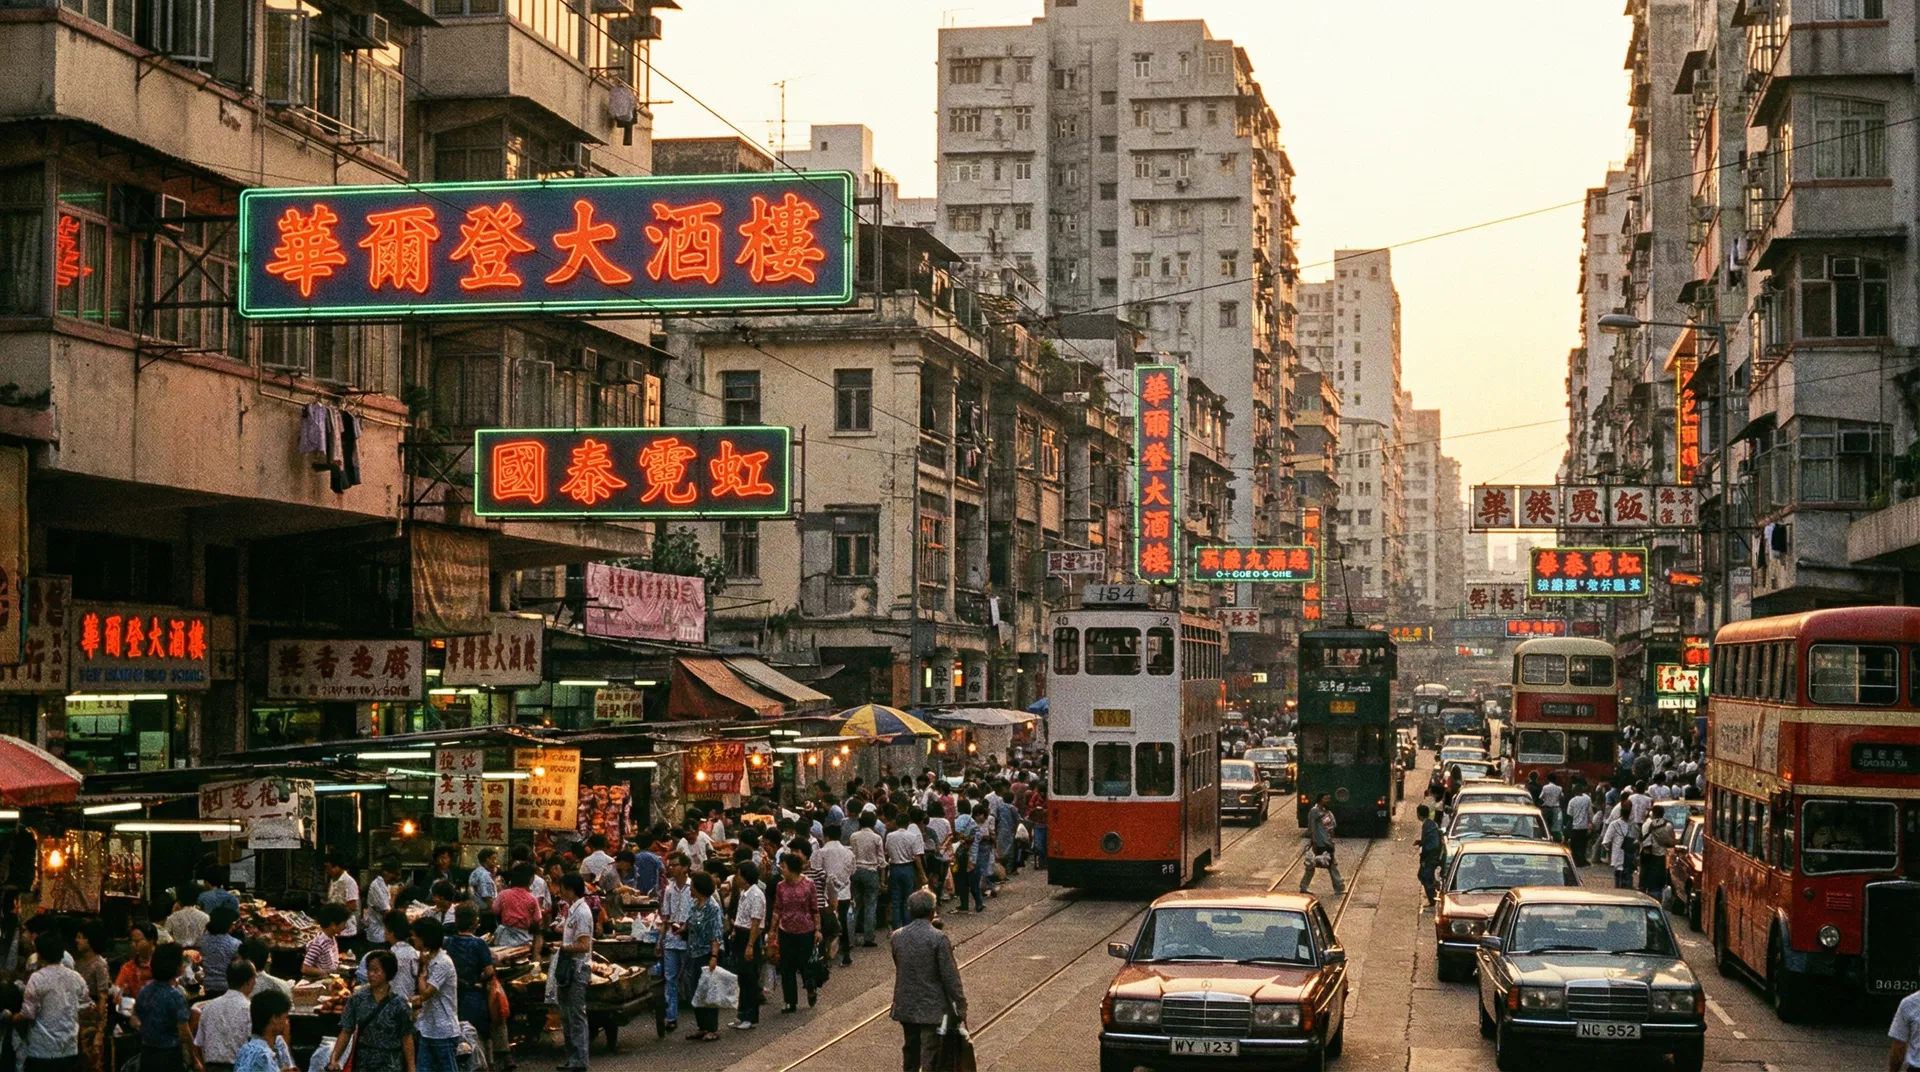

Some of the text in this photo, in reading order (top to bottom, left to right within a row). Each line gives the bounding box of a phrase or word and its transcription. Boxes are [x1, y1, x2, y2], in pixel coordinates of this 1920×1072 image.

[266, 192, 825, 297] 華爾登大酒樓
[491, 437, 774, 504] 國泰霓虹
[1099, 587, 1135, 601] 154
[1055, 616, 1069, 626] 40
[81, 612, 206, 660] 華爾登大酒樓
[1582, 1024, 1636, 1037] NC 952
[1175, 1040, 1195, 1052] WY
